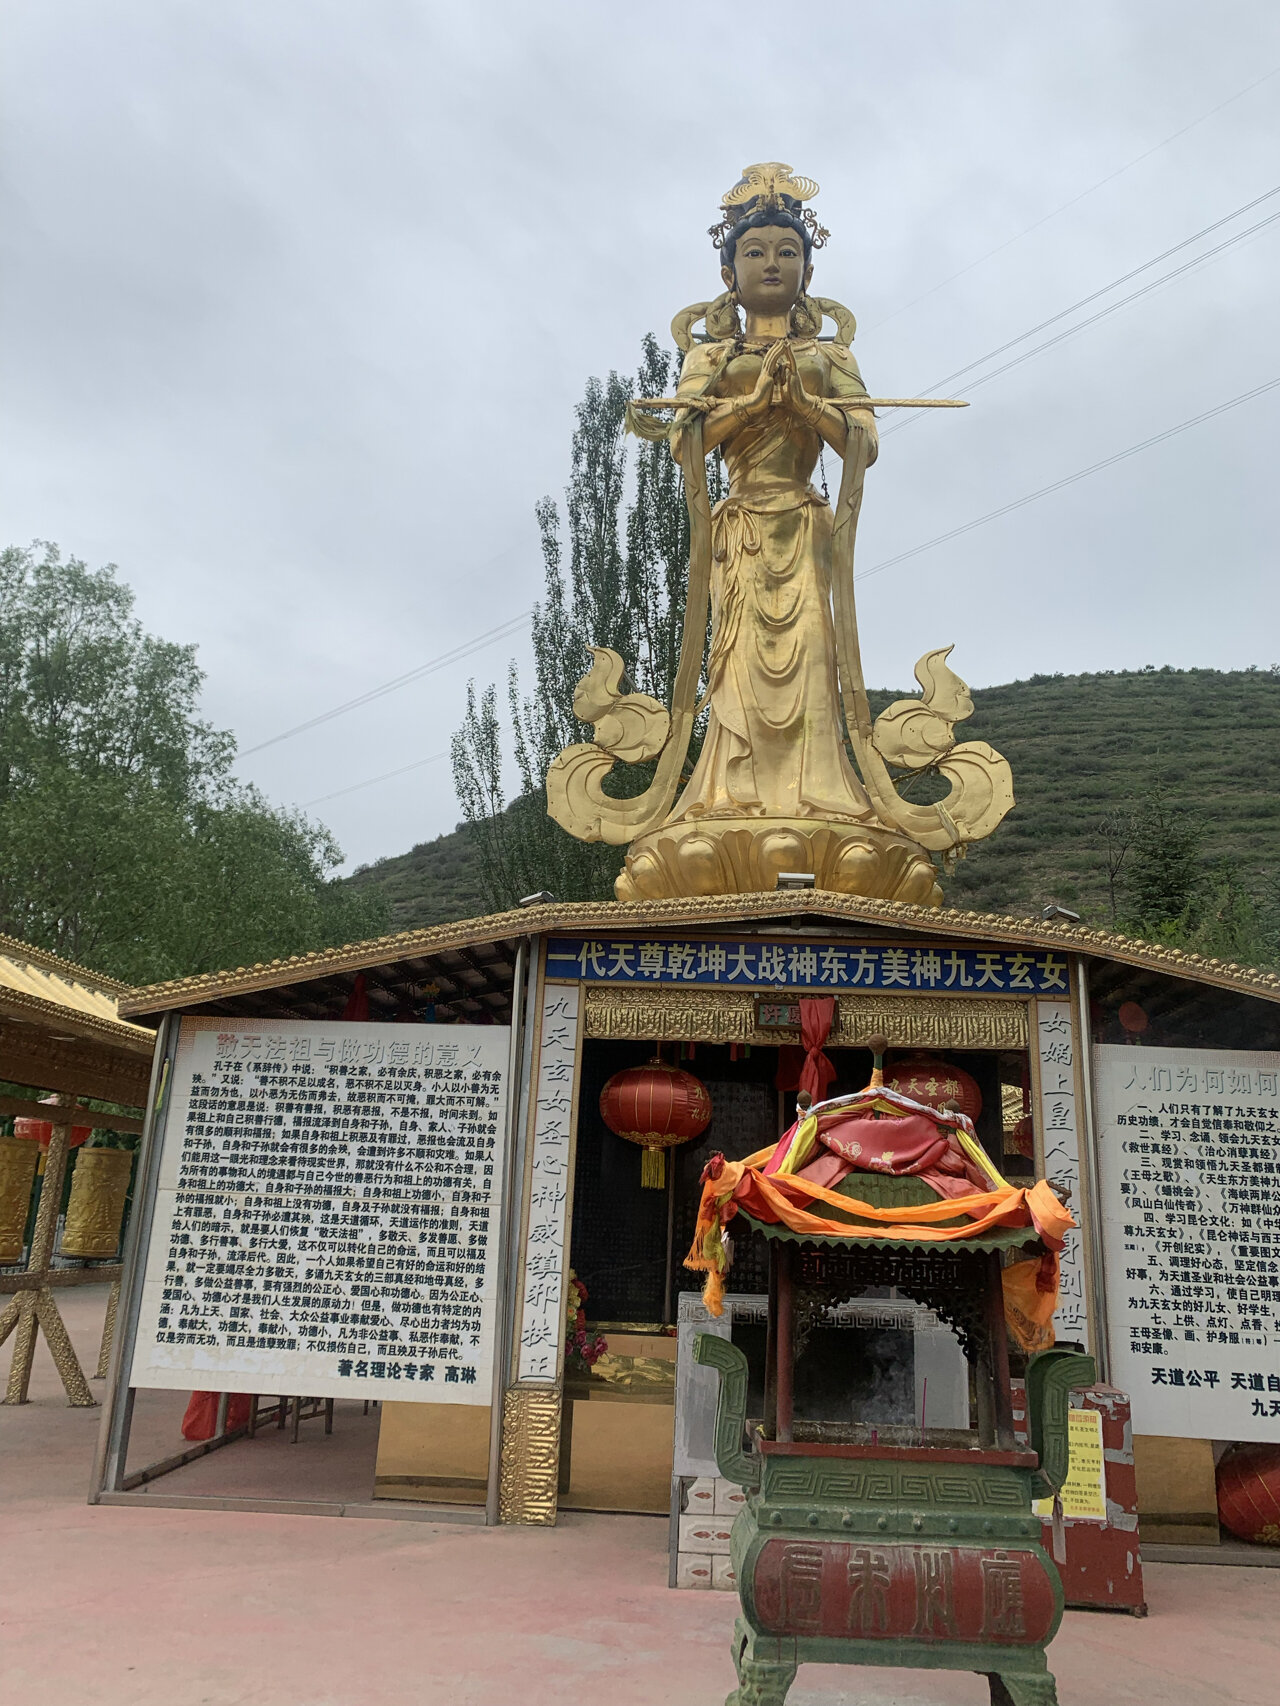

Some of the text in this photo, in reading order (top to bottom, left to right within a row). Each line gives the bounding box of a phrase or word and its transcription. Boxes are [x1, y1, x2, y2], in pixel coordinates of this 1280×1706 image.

[547, 941, 1068, 991] 一代天尊乾坤大战神东方美神九天玄女
[213, 1033, 484, 1068] 敬天法祖与做功德的意义
[889, 1077, 960, 1098] 九天圣都
[1123, 1063, 1280, 1098] 人们为何如何
[1129, 1340, 1169, 1355] 和安康。
[336, 1358, 477, 1384] 著名理论专家 高琳
[1150, 1366, 1220, 1389] 天道公平
